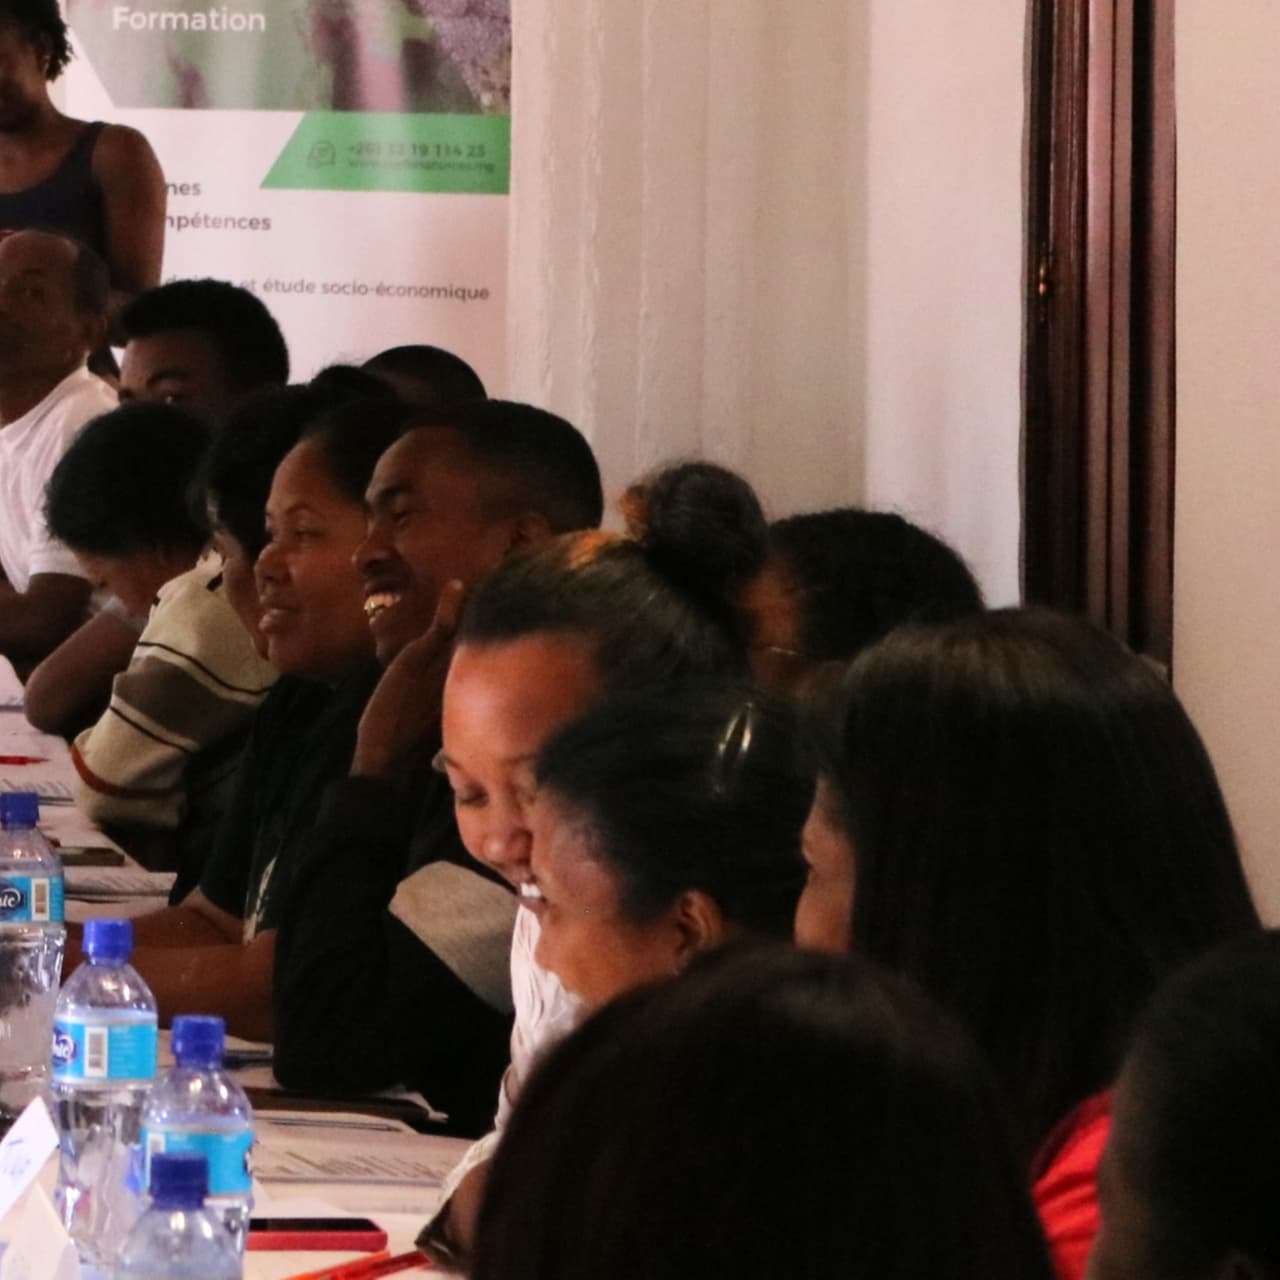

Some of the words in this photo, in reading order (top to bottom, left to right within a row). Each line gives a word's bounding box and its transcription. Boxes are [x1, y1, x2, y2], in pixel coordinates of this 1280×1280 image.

[112, 6, 267, 32] Formation
[263, 277, 316, 294] étude
[320, 278, 491, 303] socio-économique
